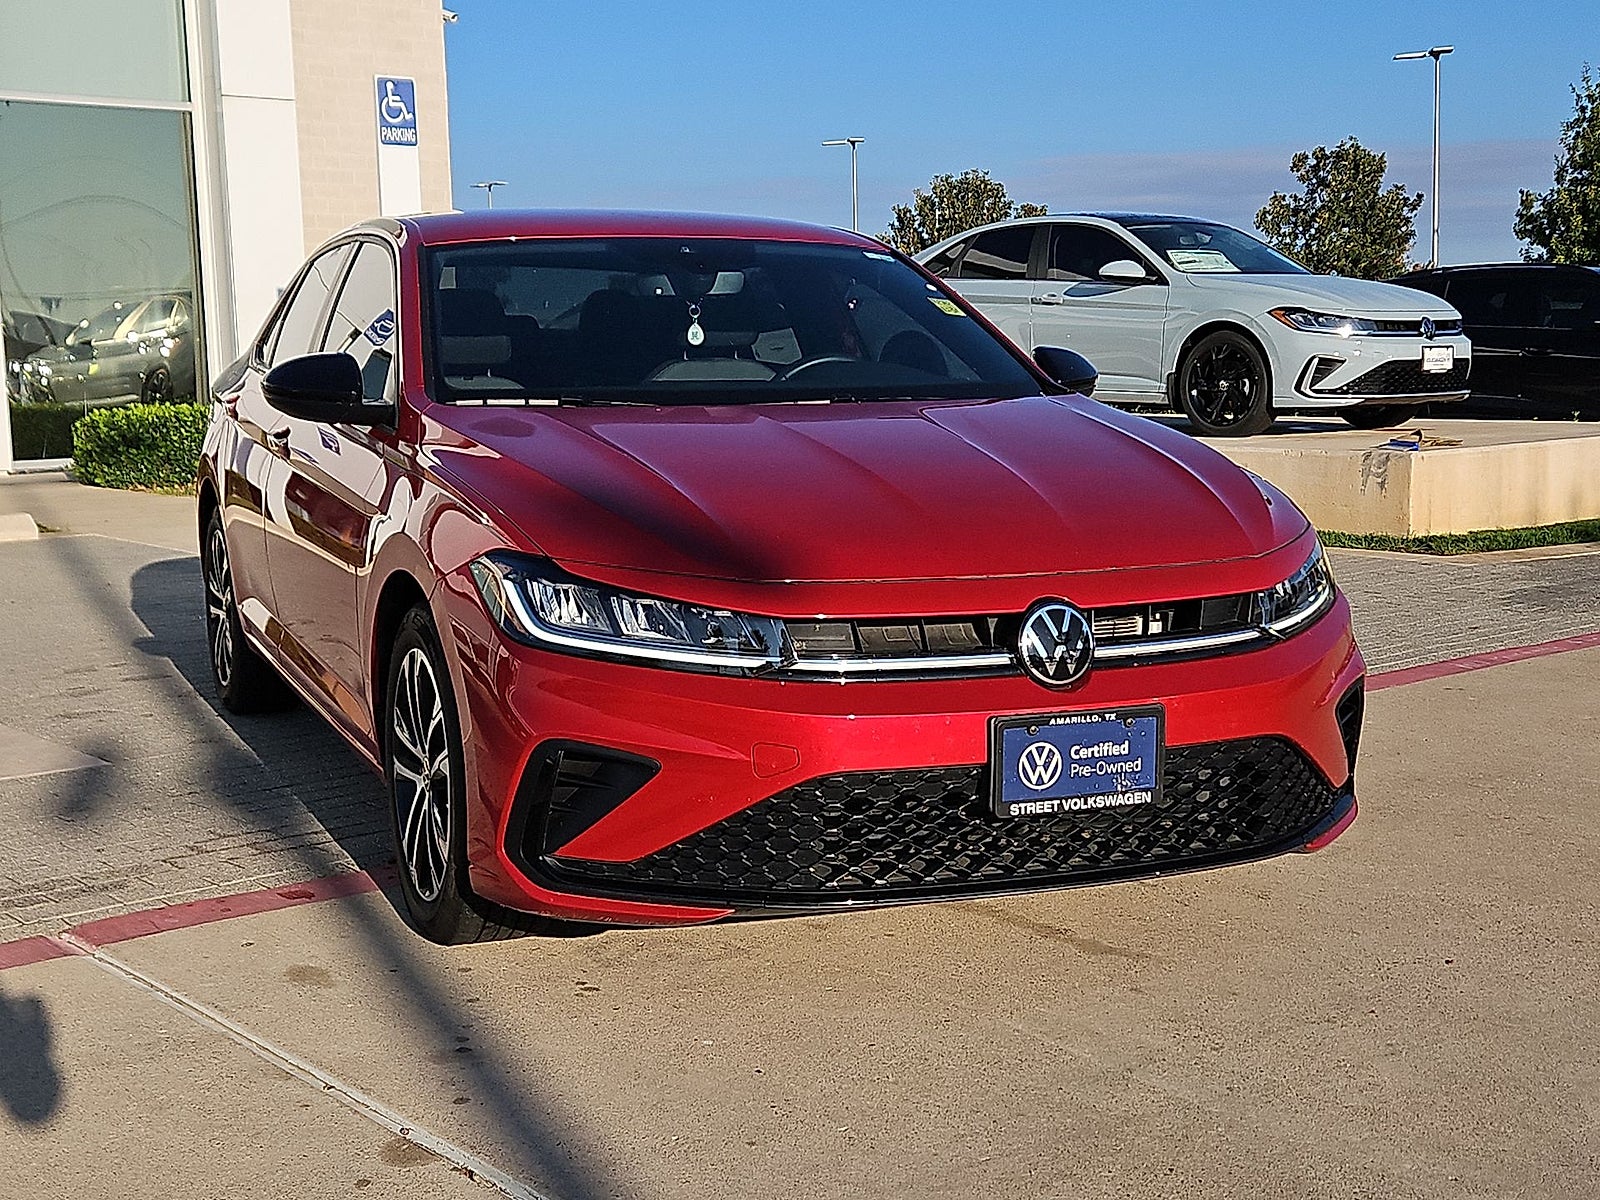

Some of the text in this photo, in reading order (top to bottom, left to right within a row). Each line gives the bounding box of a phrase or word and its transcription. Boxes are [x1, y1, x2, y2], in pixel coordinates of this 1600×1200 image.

[381, 127, 416, 142] PARKING
[1049, 713, 1117, 726] AMARILLO, TX
[1070, 740, 1129, 760] Certified
[1070, 757, 1142, 778] Pre-Owned
[1009, 791, 1152, 816] STREET VOLKSWAGEN
